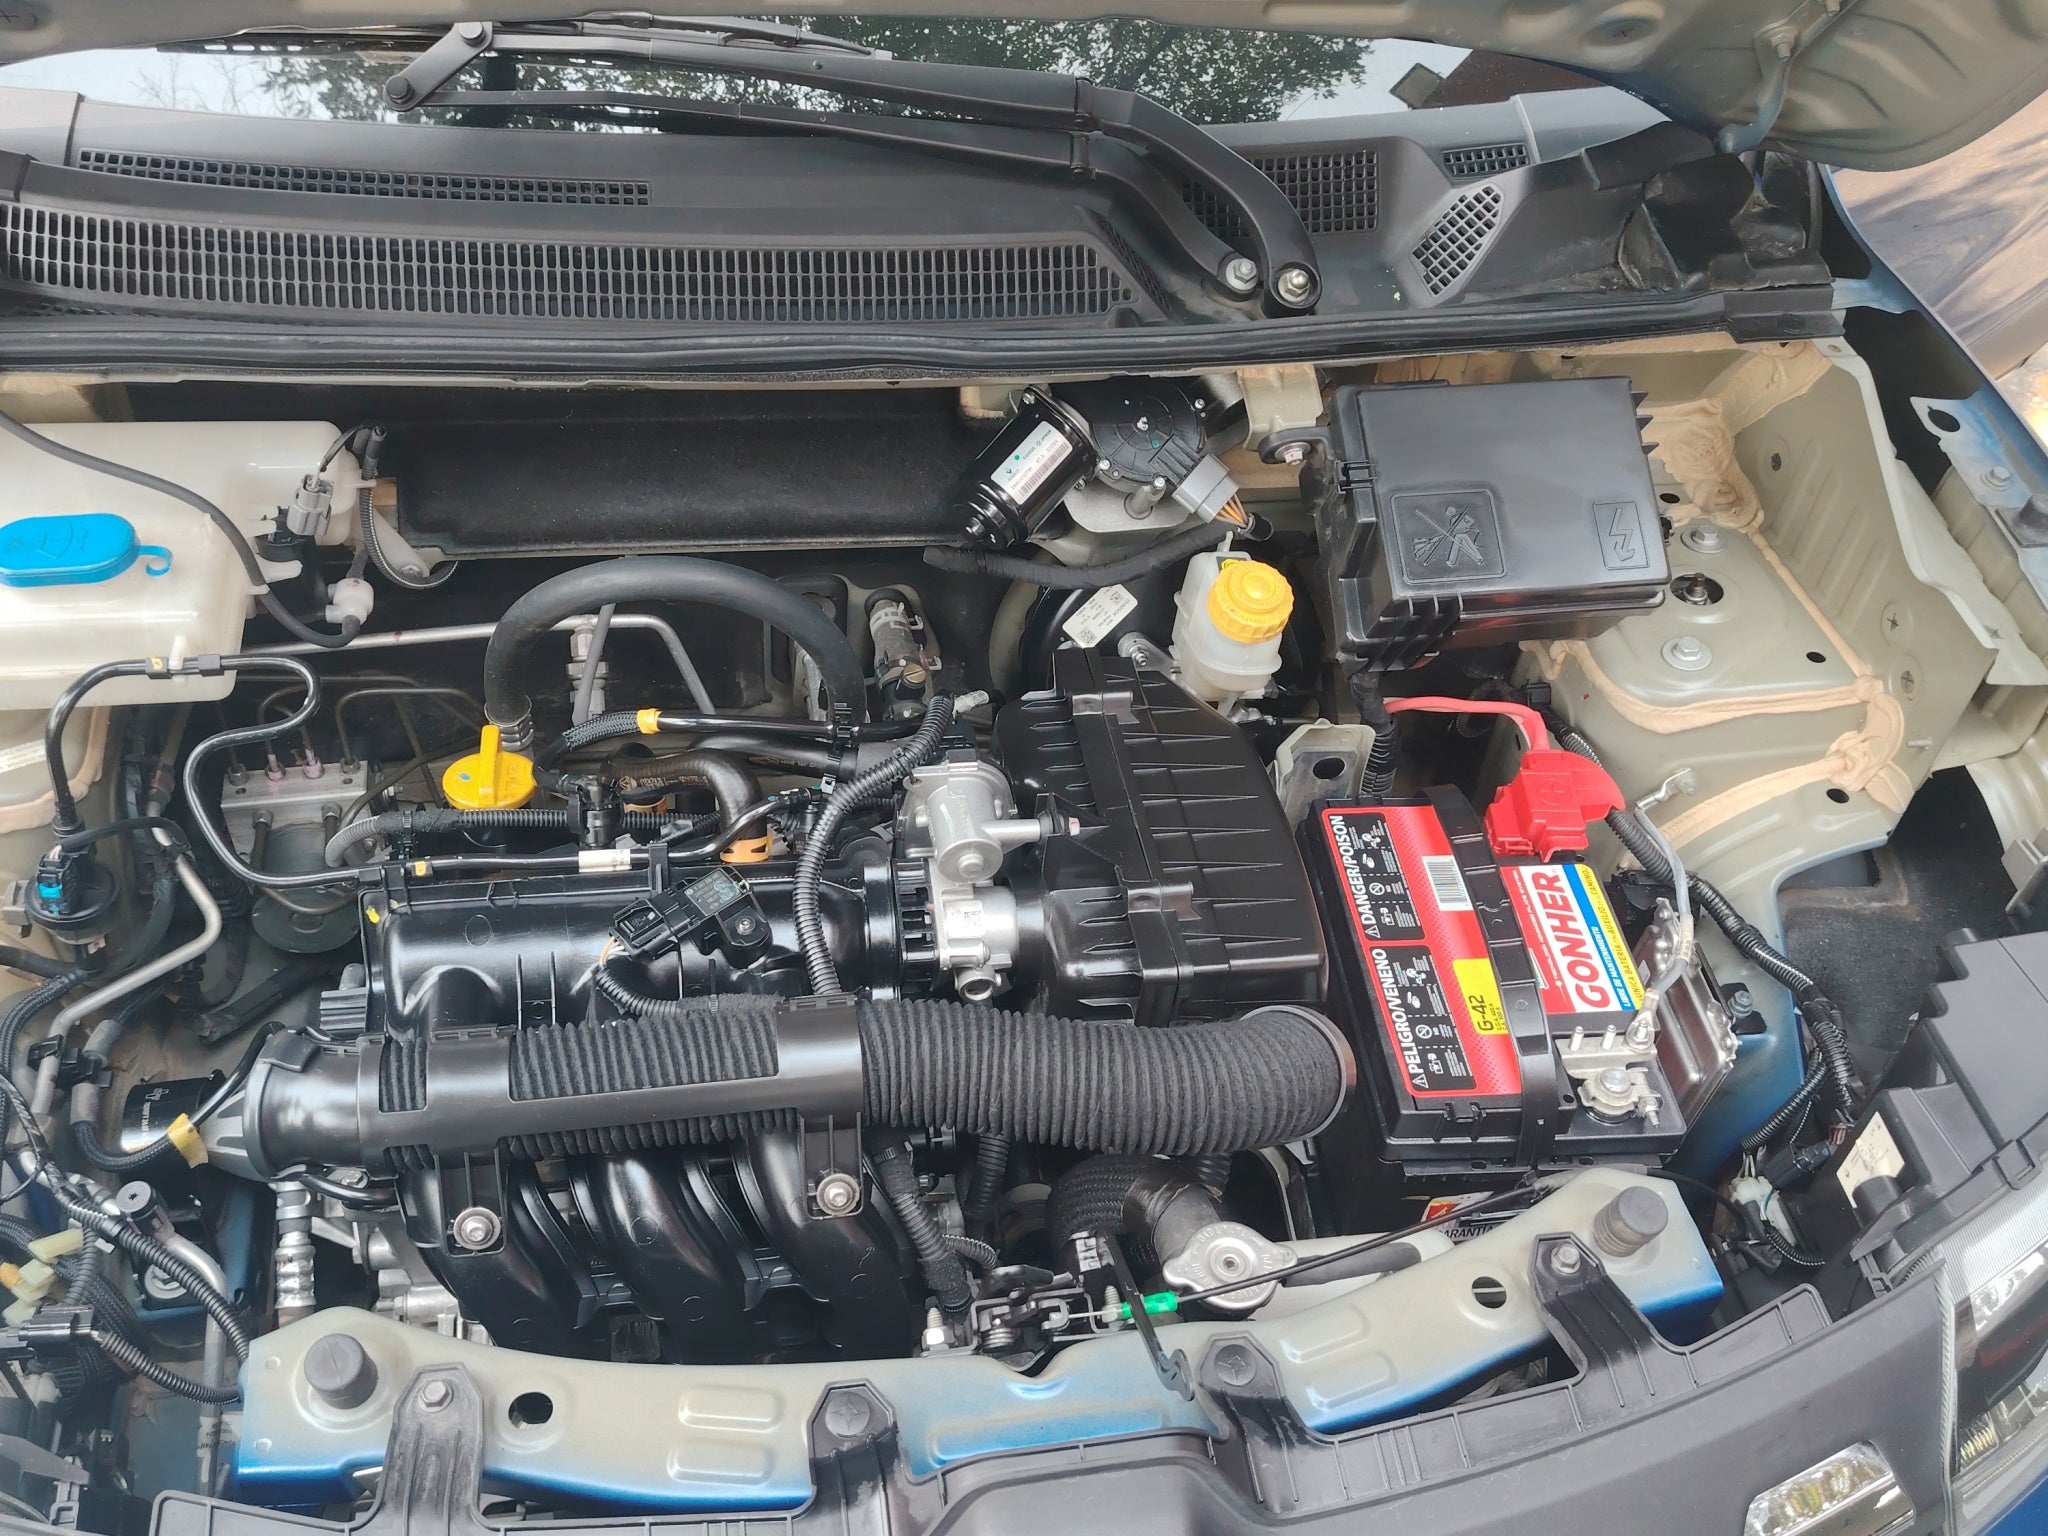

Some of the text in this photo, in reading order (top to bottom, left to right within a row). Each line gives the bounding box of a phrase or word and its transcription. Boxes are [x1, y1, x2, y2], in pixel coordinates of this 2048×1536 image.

[1329, 815, 1378, 925] DANGER/POISON
[1531, 871, 1612, 1009] GONHER
[1590, 925, 1619, 978] MANTENIMIENTO
[1371, 948, 1425, 1074] PELIGRO/VENENO
[1468, 995, 1494, 1031] G-42
